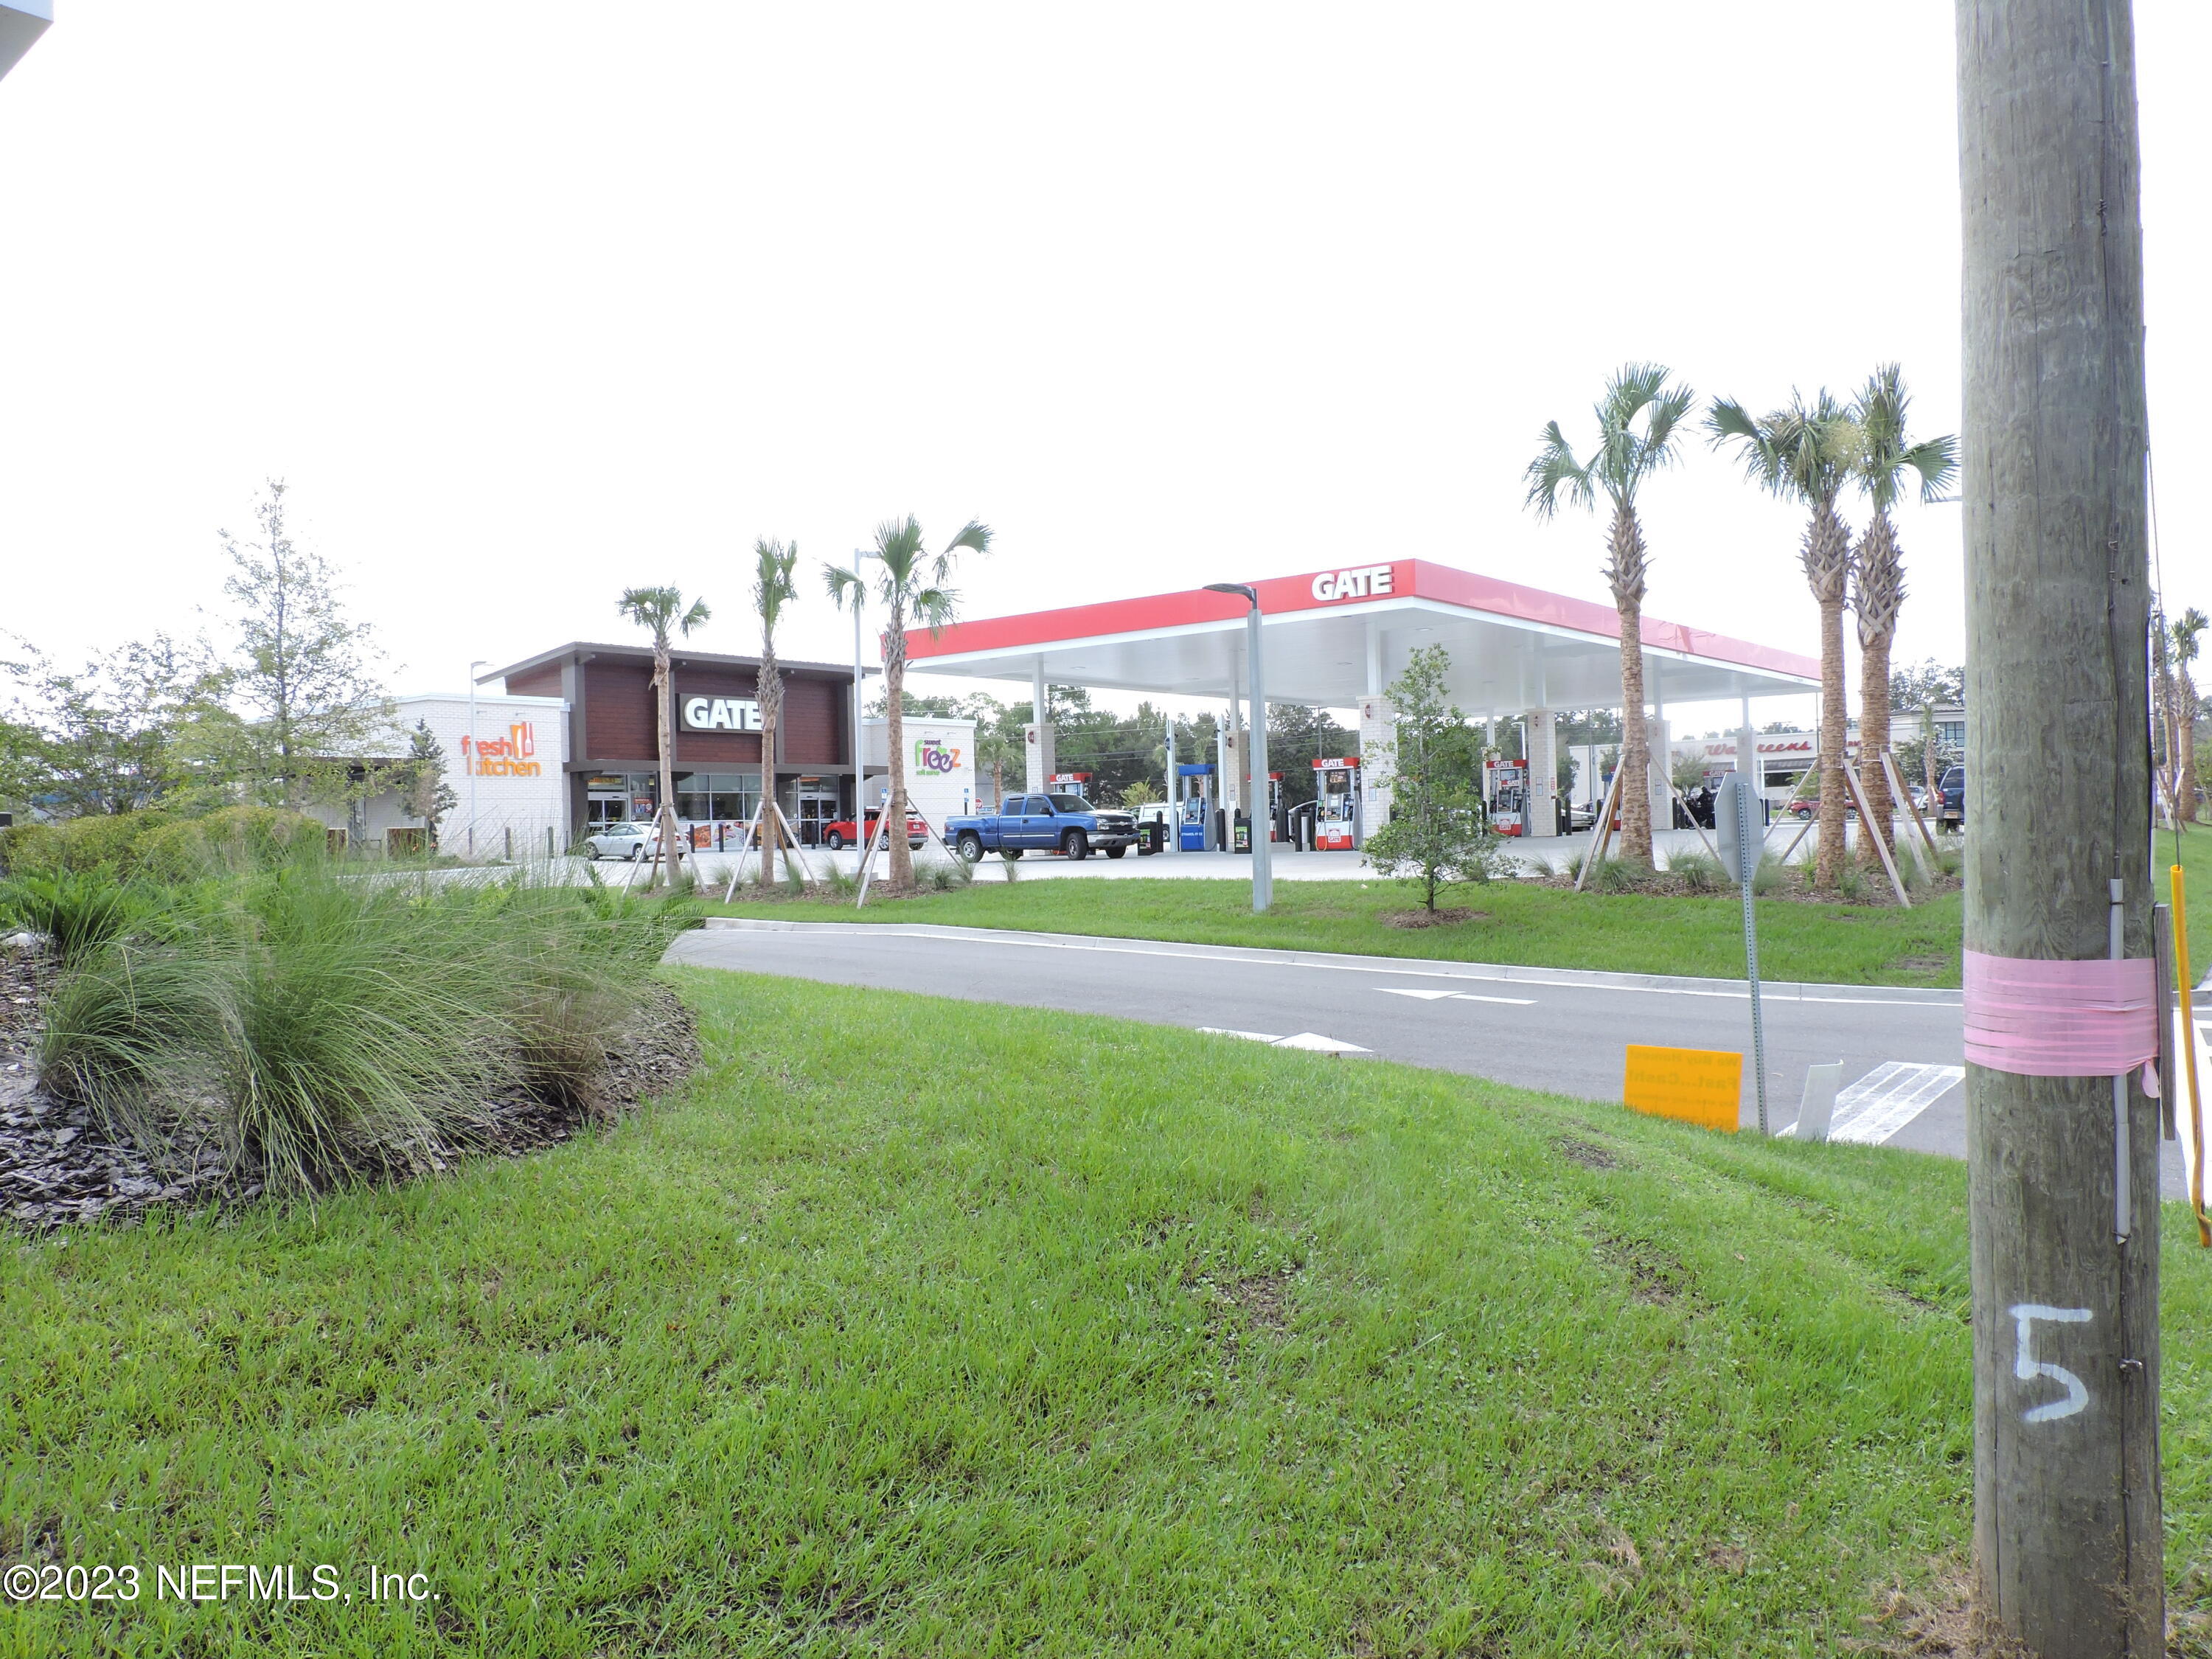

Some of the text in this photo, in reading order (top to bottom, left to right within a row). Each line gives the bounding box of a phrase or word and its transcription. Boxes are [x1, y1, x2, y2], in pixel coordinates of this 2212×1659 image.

[1312, 565, 1393, 601] GATE
[684, 698, 763, 730] GATE
[1321, 759, 1344, 767] GATE
[2008, 1304, 2093, 1422] 5
